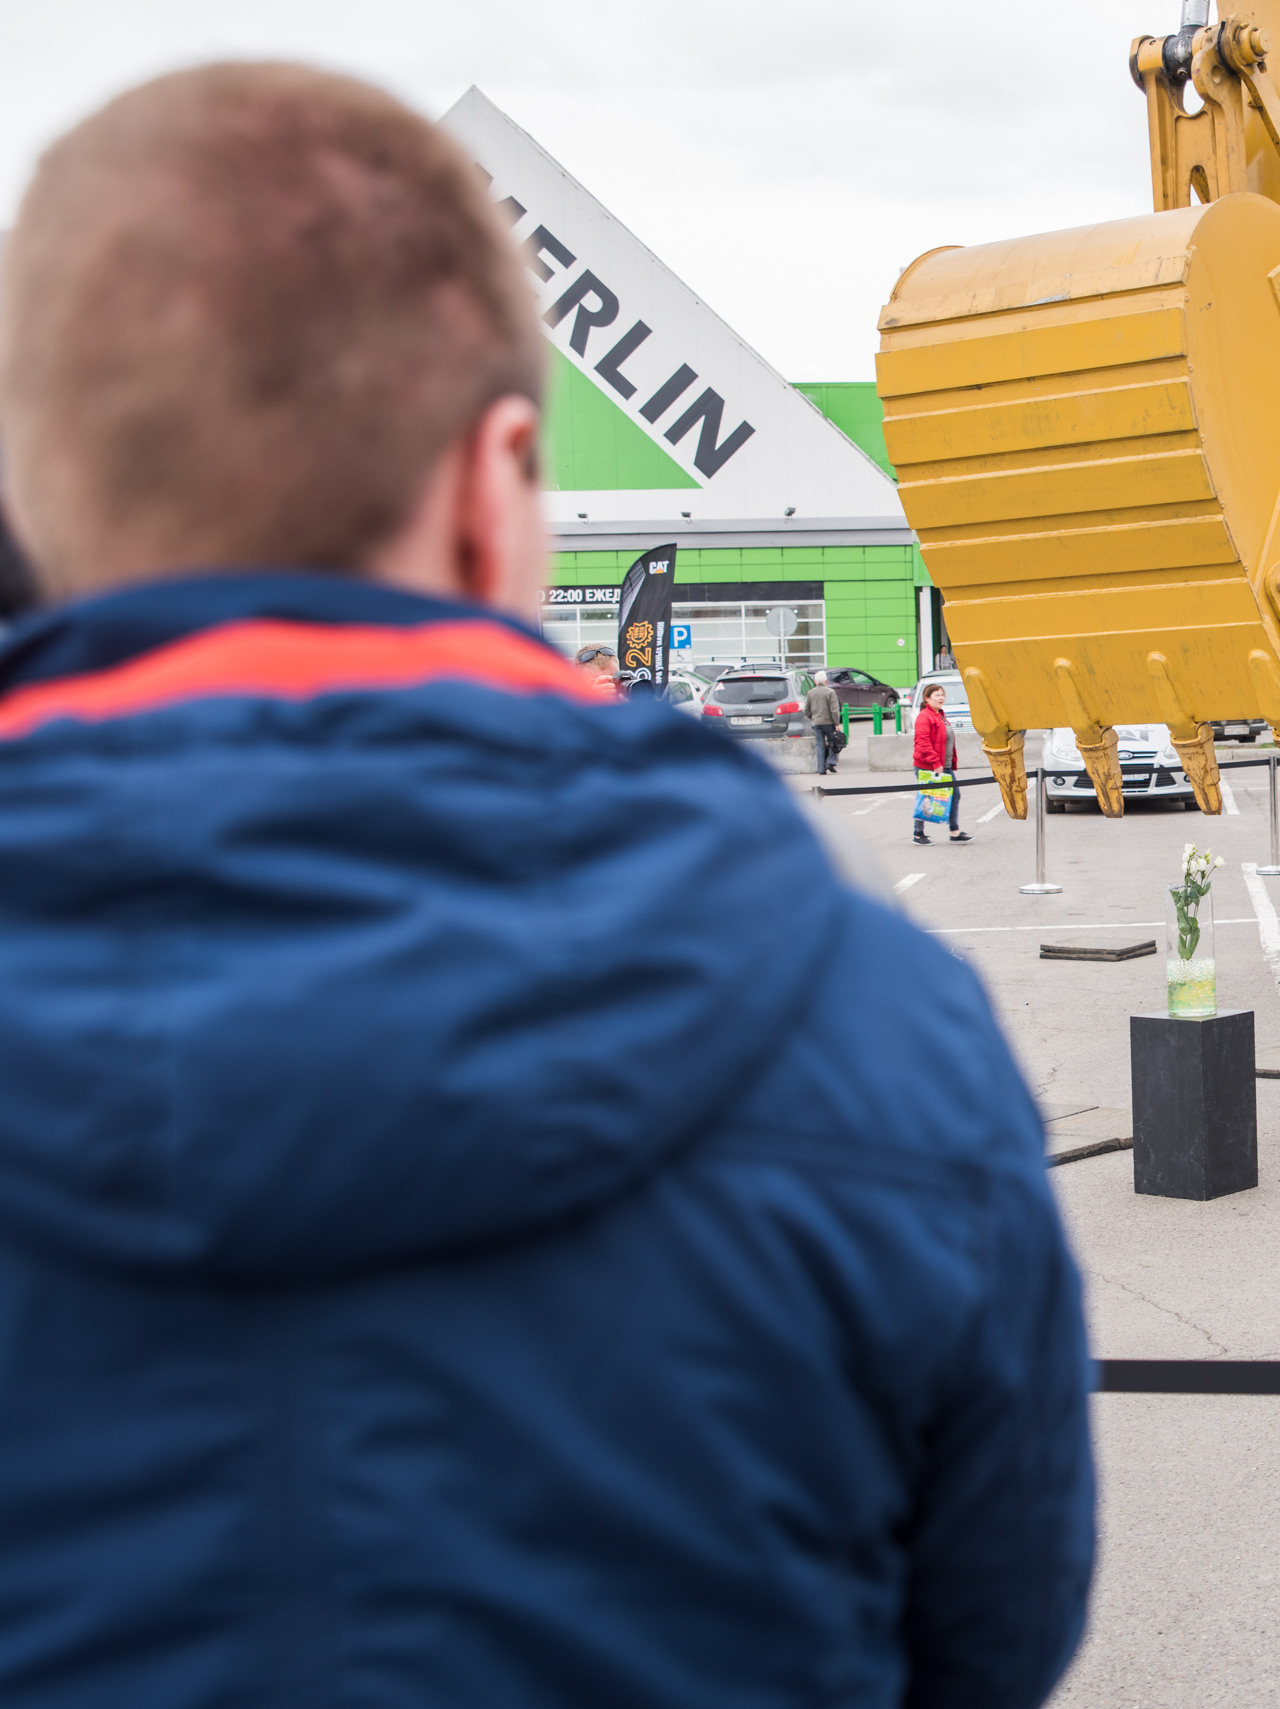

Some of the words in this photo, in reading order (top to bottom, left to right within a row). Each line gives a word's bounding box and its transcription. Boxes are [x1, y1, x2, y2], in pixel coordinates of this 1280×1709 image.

[473, 162, 756, 479] ERLIN
[649, 561, 669, 574] CAT
[549, 589, 583, 603] 22:00
[585, 589, 621, 604] ЕЖЕД
[673, 627, 688, 648] P
